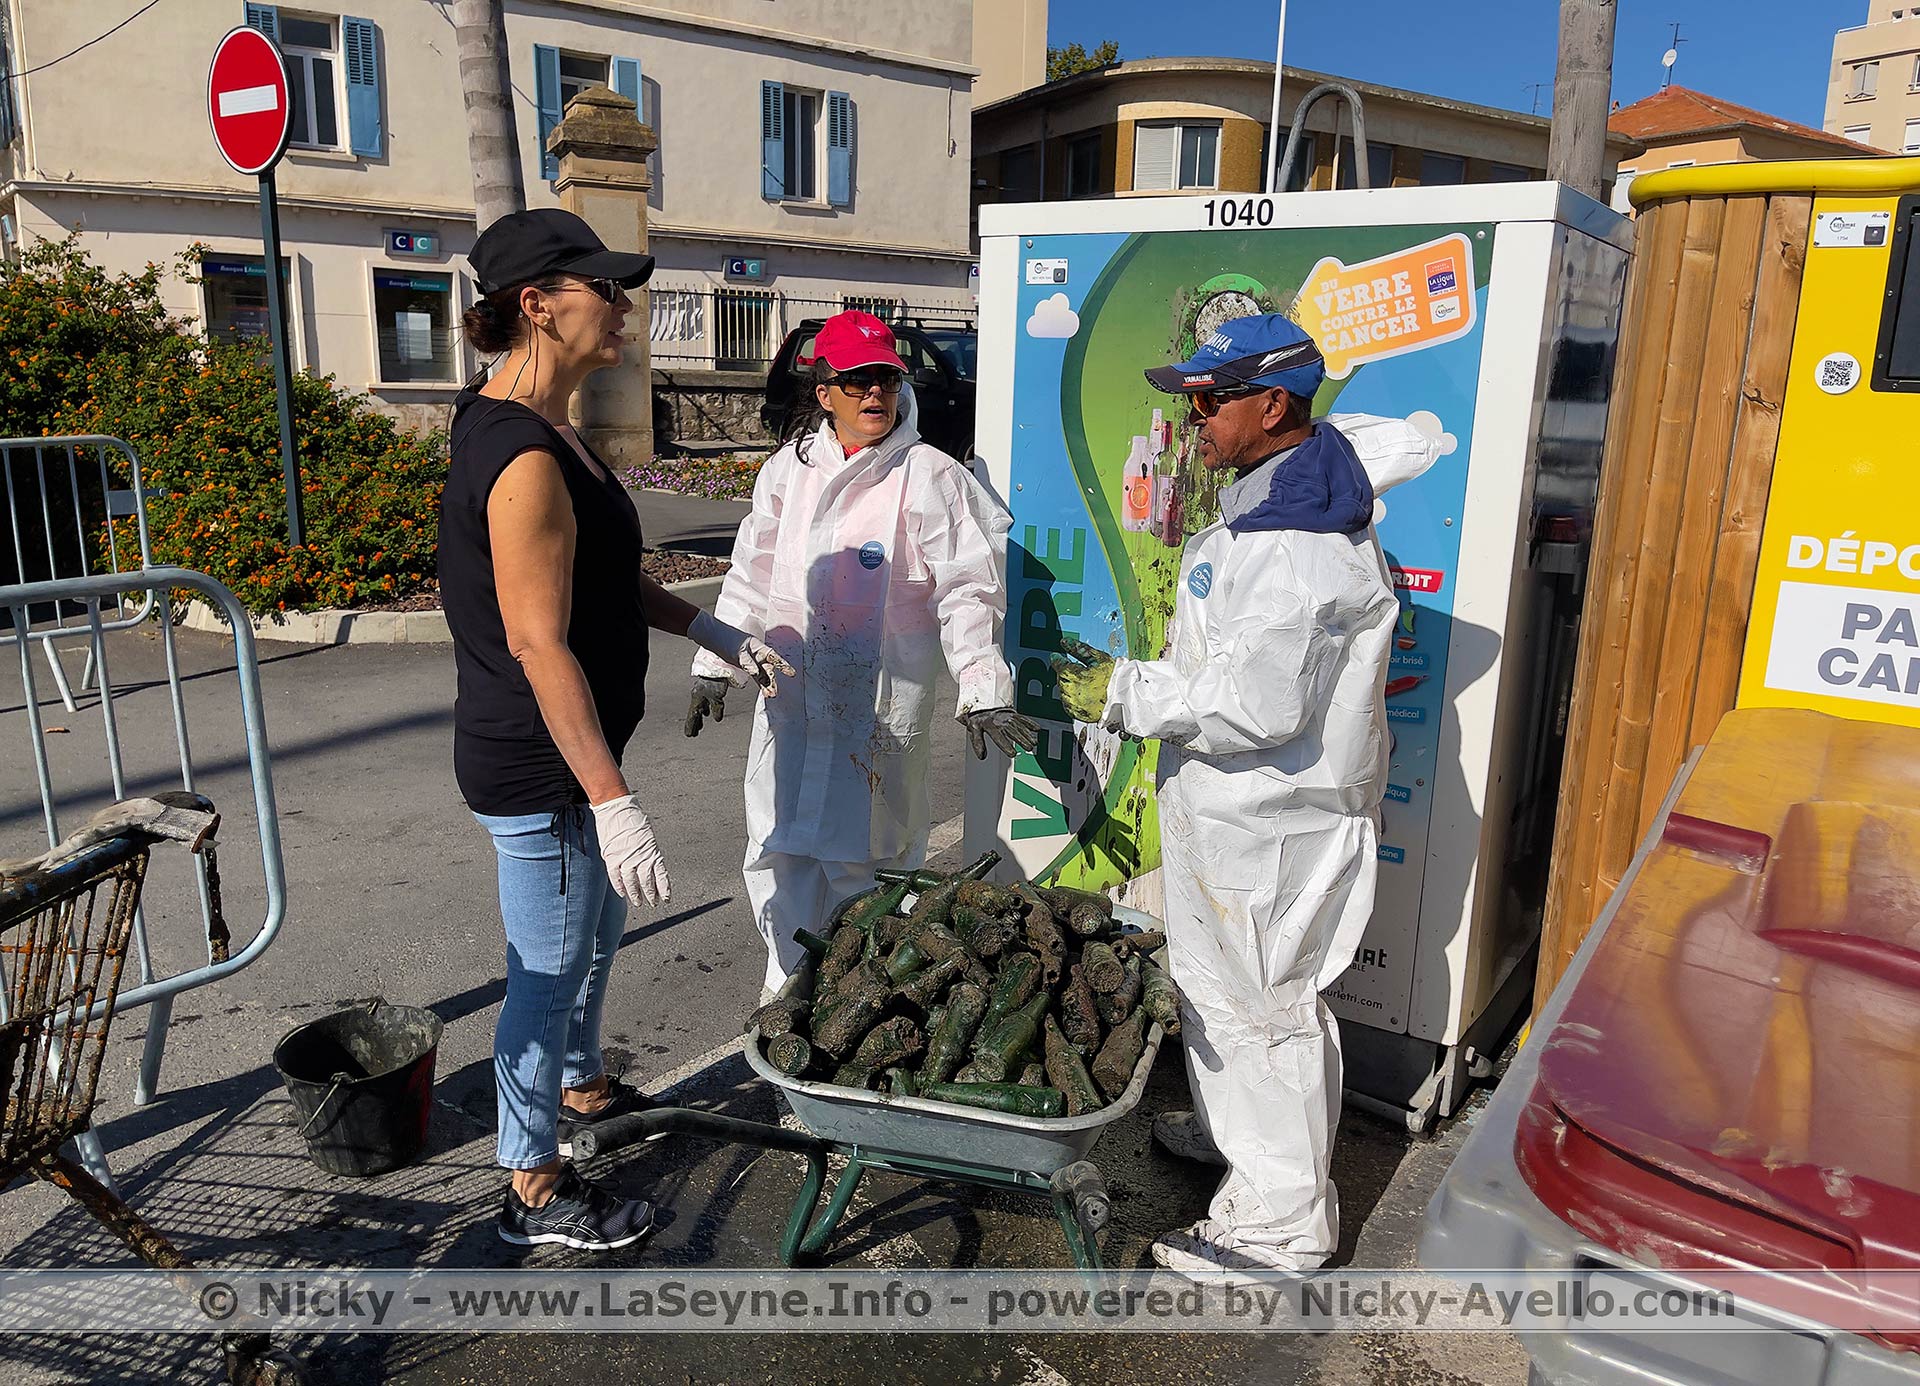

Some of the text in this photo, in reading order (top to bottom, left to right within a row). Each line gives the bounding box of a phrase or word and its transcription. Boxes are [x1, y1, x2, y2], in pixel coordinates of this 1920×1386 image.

[1204, 198, 1274, 226] 1040
[395, 235, 428, 250] CIC
[732, 261, 758, 274] CIC
[1313, 270, 1412, 317] VERRE
[1320, 278, 1339, 293] DU
[1320, 296, 1417, 333] CONTRE LE
[1322, 312, 1421, 353] CANCER
[1391, 572, 1433, 588] RDIT
[1389, 654, 1424, 666] oir brisé
[1378, 847, 1399, 859] laine
[1319, 988, 1384, 1010] ourletri.com
